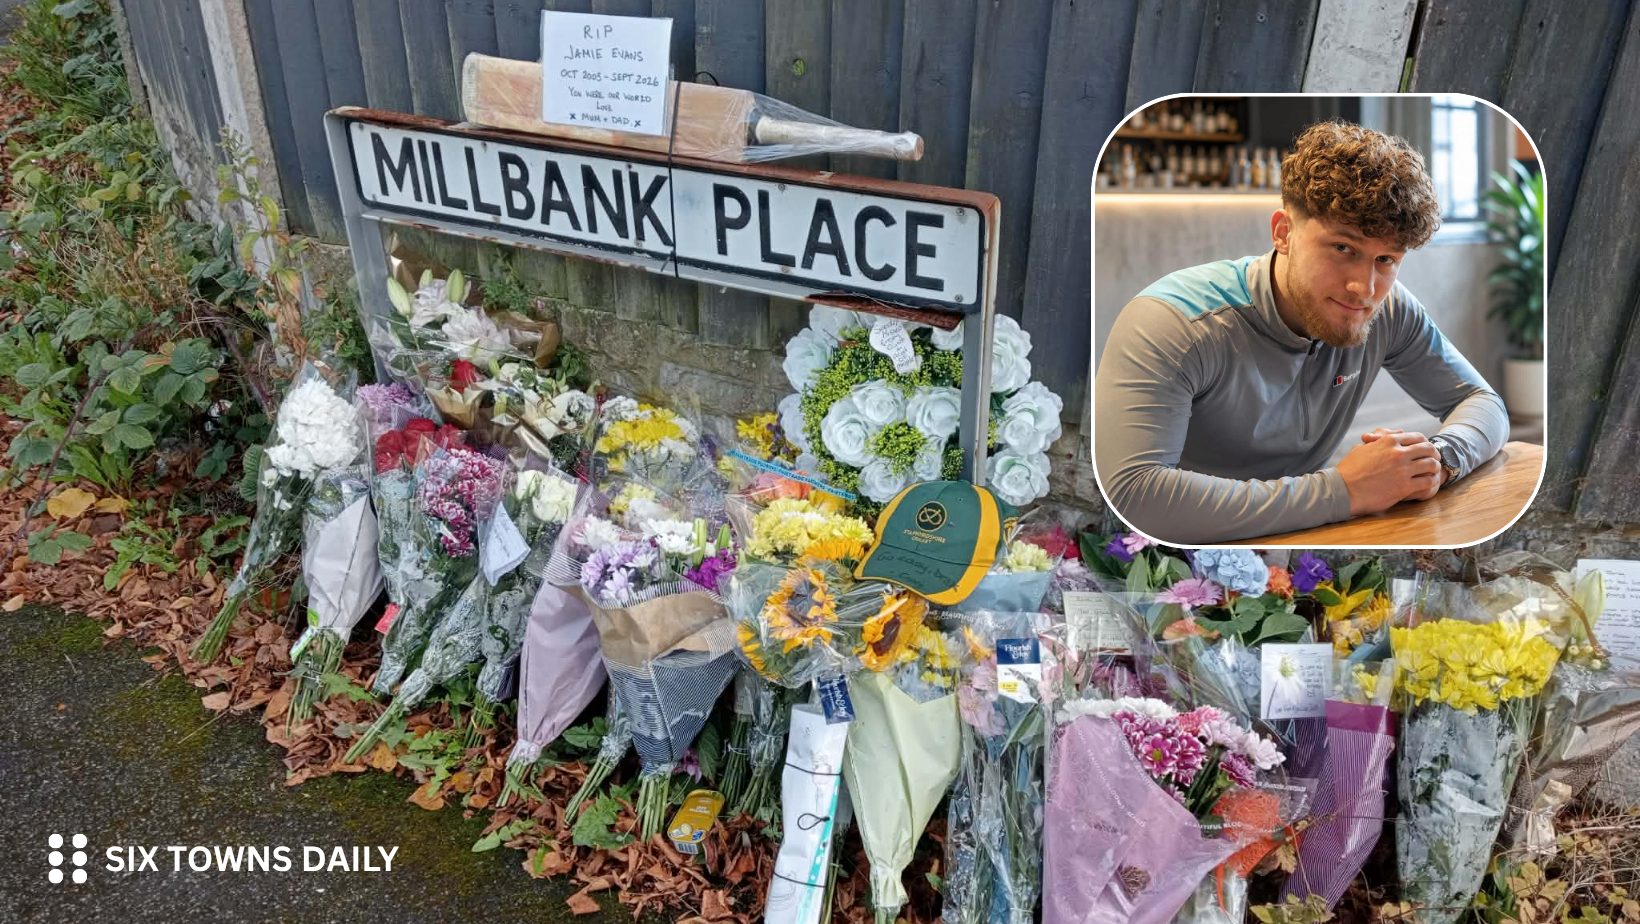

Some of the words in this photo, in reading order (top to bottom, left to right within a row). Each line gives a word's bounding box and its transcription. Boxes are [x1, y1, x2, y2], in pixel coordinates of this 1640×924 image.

[583, 25, 613, 39] RIP
[564, 44, 603, 60] JAMIE
[612, 47, 644, 62] EVANS
[560, 69, 578, 79] OCT
[610, 72, 634, 82] SEPT
[635, 76, 659, 87] 2026
[581, 113, 601, 122] MUM
[370, 132, 675, 249] MILLBANK
[713, 183, 945, 293] PLACE
